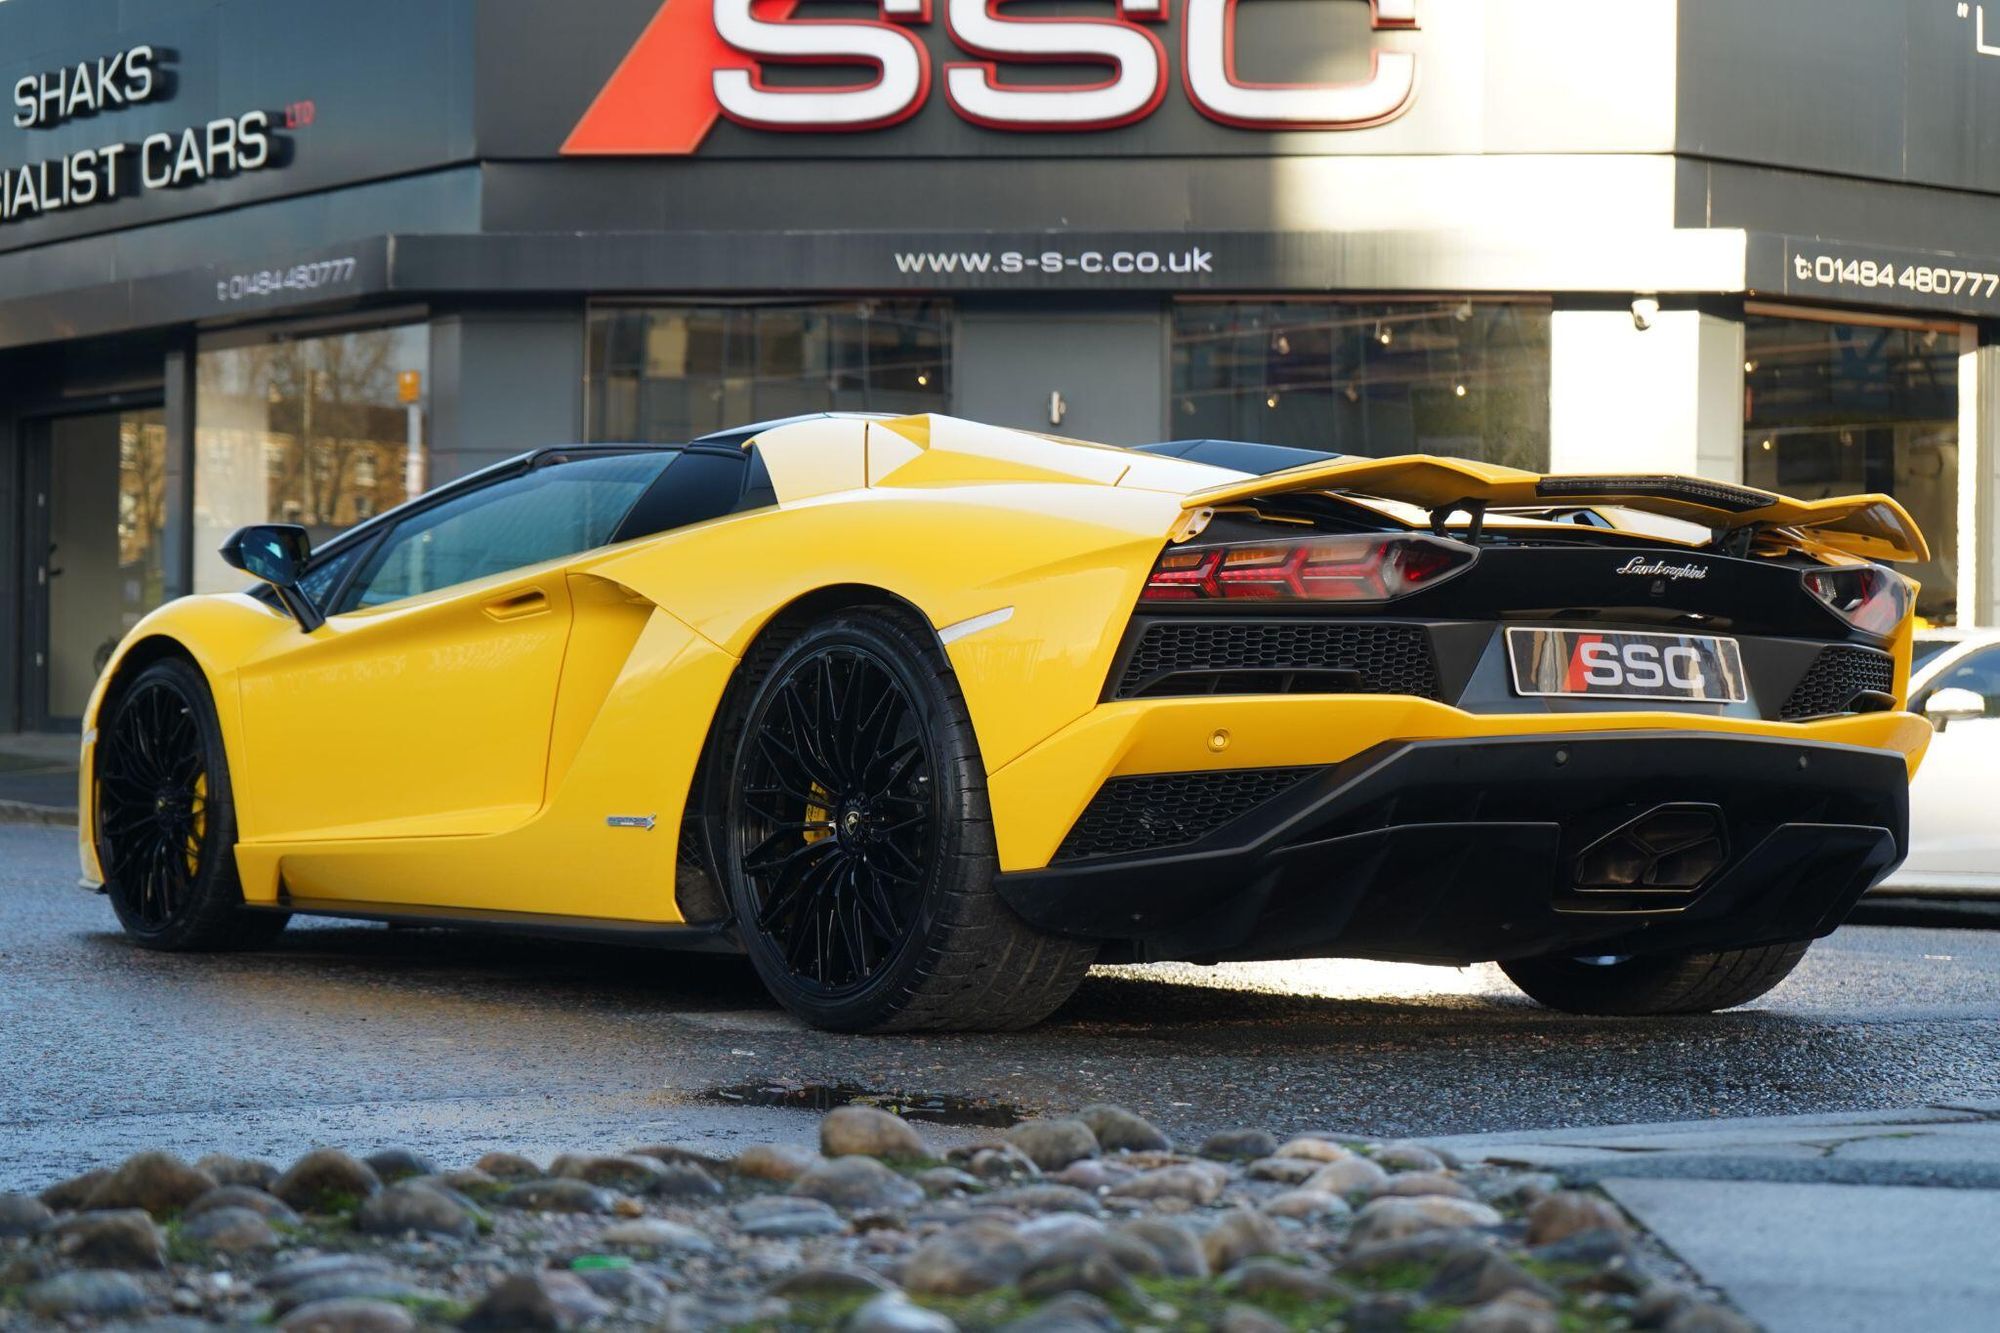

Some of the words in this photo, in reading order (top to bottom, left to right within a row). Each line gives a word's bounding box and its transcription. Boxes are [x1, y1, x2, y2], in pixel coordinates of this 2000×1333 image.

[13, 45, 153, 128] SHAKS
[712, 0, 1419, 130] SSC
[0, 143, 125, 219] IALIST
[141, 110, 268, 189] CARS
[284, 100, 316, 129] LTD
[895, 247, 1213, 273] www.s-s-c.co.uk
[1898, 265, 1999, 299] 480777
[1616, 556, 1708, 580] Lamborghini
[1580, 642, 1705, 689] SSC
